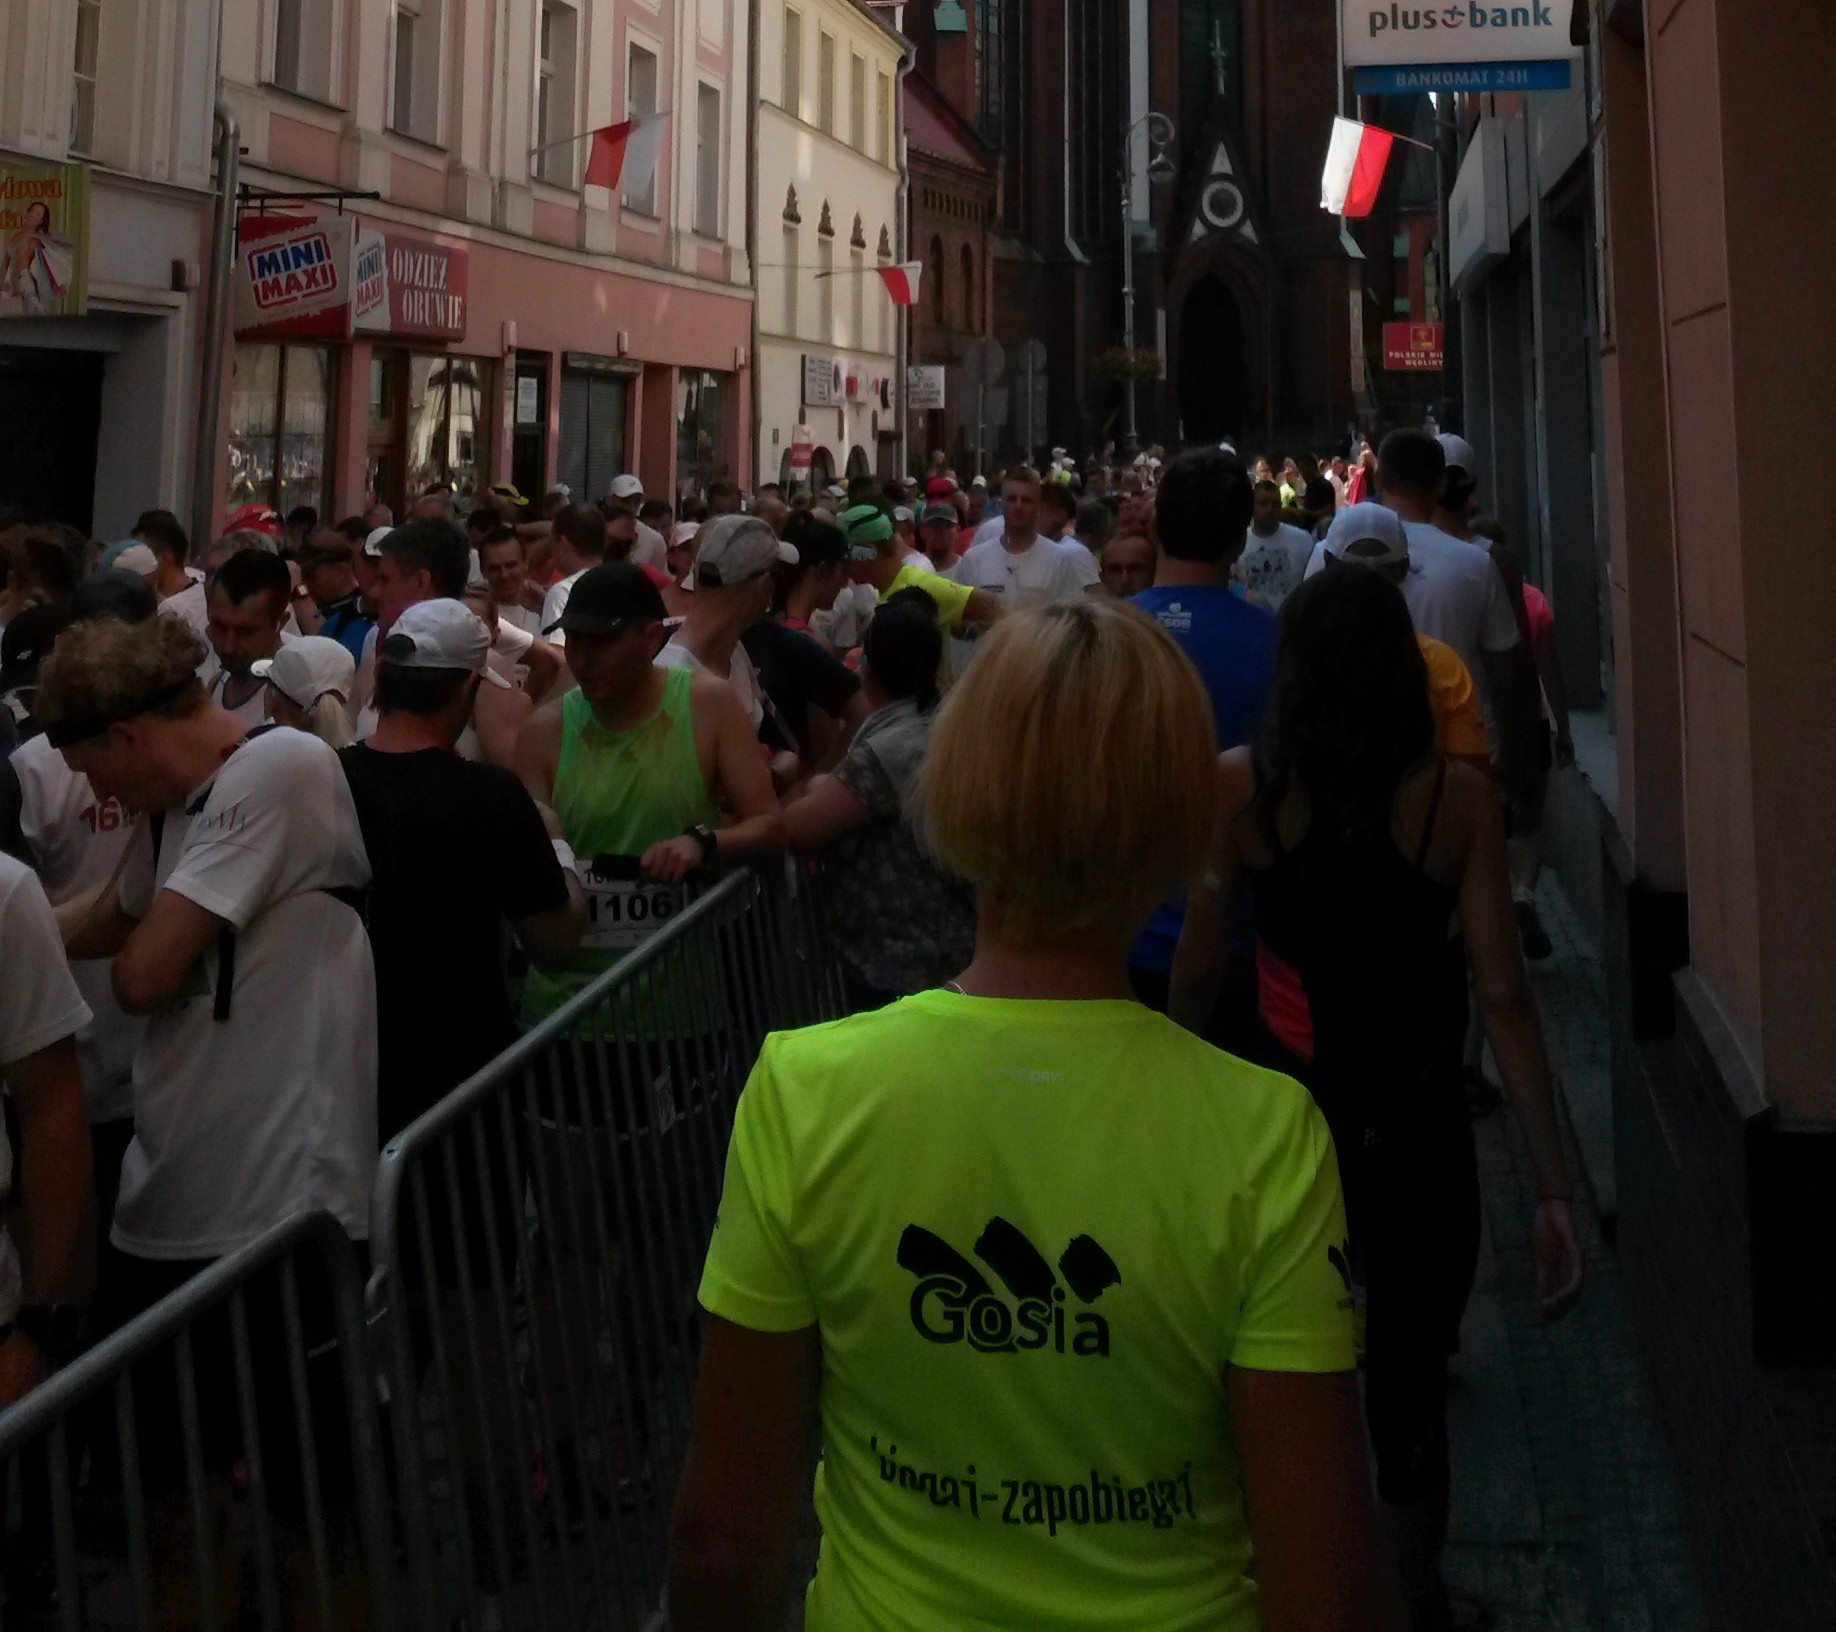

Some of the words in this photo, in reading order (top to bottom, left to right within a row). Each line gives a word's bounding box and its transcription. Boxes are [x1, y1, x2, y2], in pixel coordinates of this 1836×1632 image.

[1369, 2, 1437, 38] plus
[1468, 0, 1552, 29] bank
[1395, 70, 1489, 87] BANKOMAT
[1498, 68, 1529, 84] 24H
[257, 239, 325, 279] MINI
[261, 263, 329, 302] MAXI
[402, 289, 463, 329] OBUWIE
[909, 1274, 1111, 1357] Gosia
